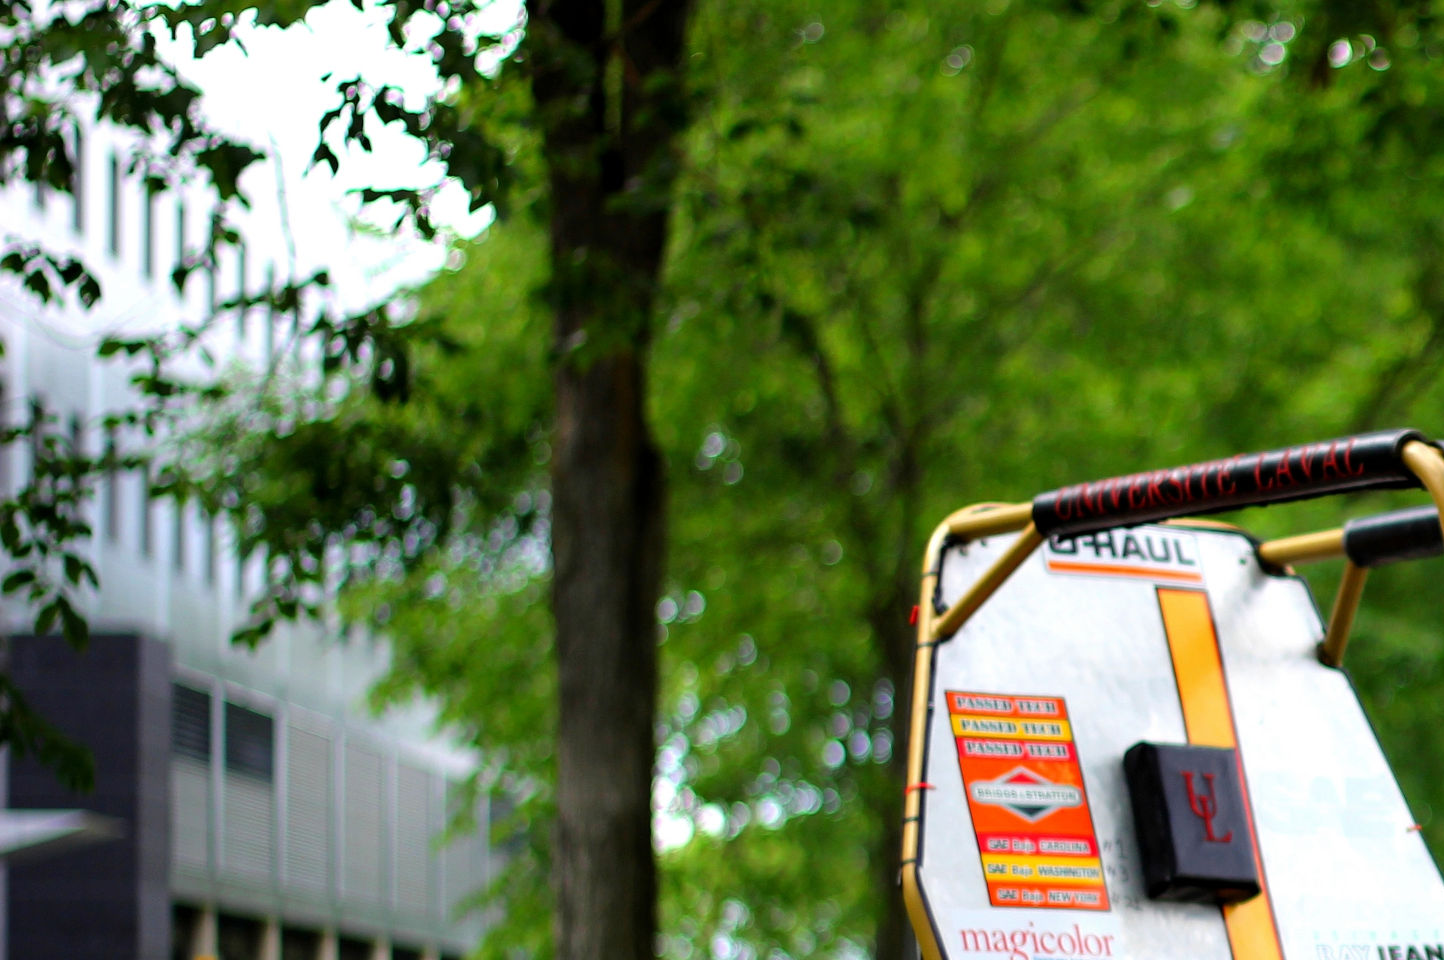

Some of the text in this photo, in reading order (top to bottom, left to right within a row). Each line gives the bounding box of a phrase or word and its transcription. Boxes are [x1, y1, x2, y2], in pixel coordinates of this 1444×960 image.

[1254, 438, 1364, 492] LAVAL
[956, 696, 1056, 713] PASSED TECH
[961, 719, 1061, 735] PASSED TECH
[966, 741, 1068, 757] PASSED TECH
[989, 840, 1009, 850] SAE
[1040, 841, 1089, 853] CAROLINA
[988, 864, 1007, 873] SAE
[1039, 866, 1099, 878] WASHINGTON
[998, 889, 1017, 900] SAE
[1049, 891, 1071, 902] NEW
[1075, 892, 1098, 903] YORK
